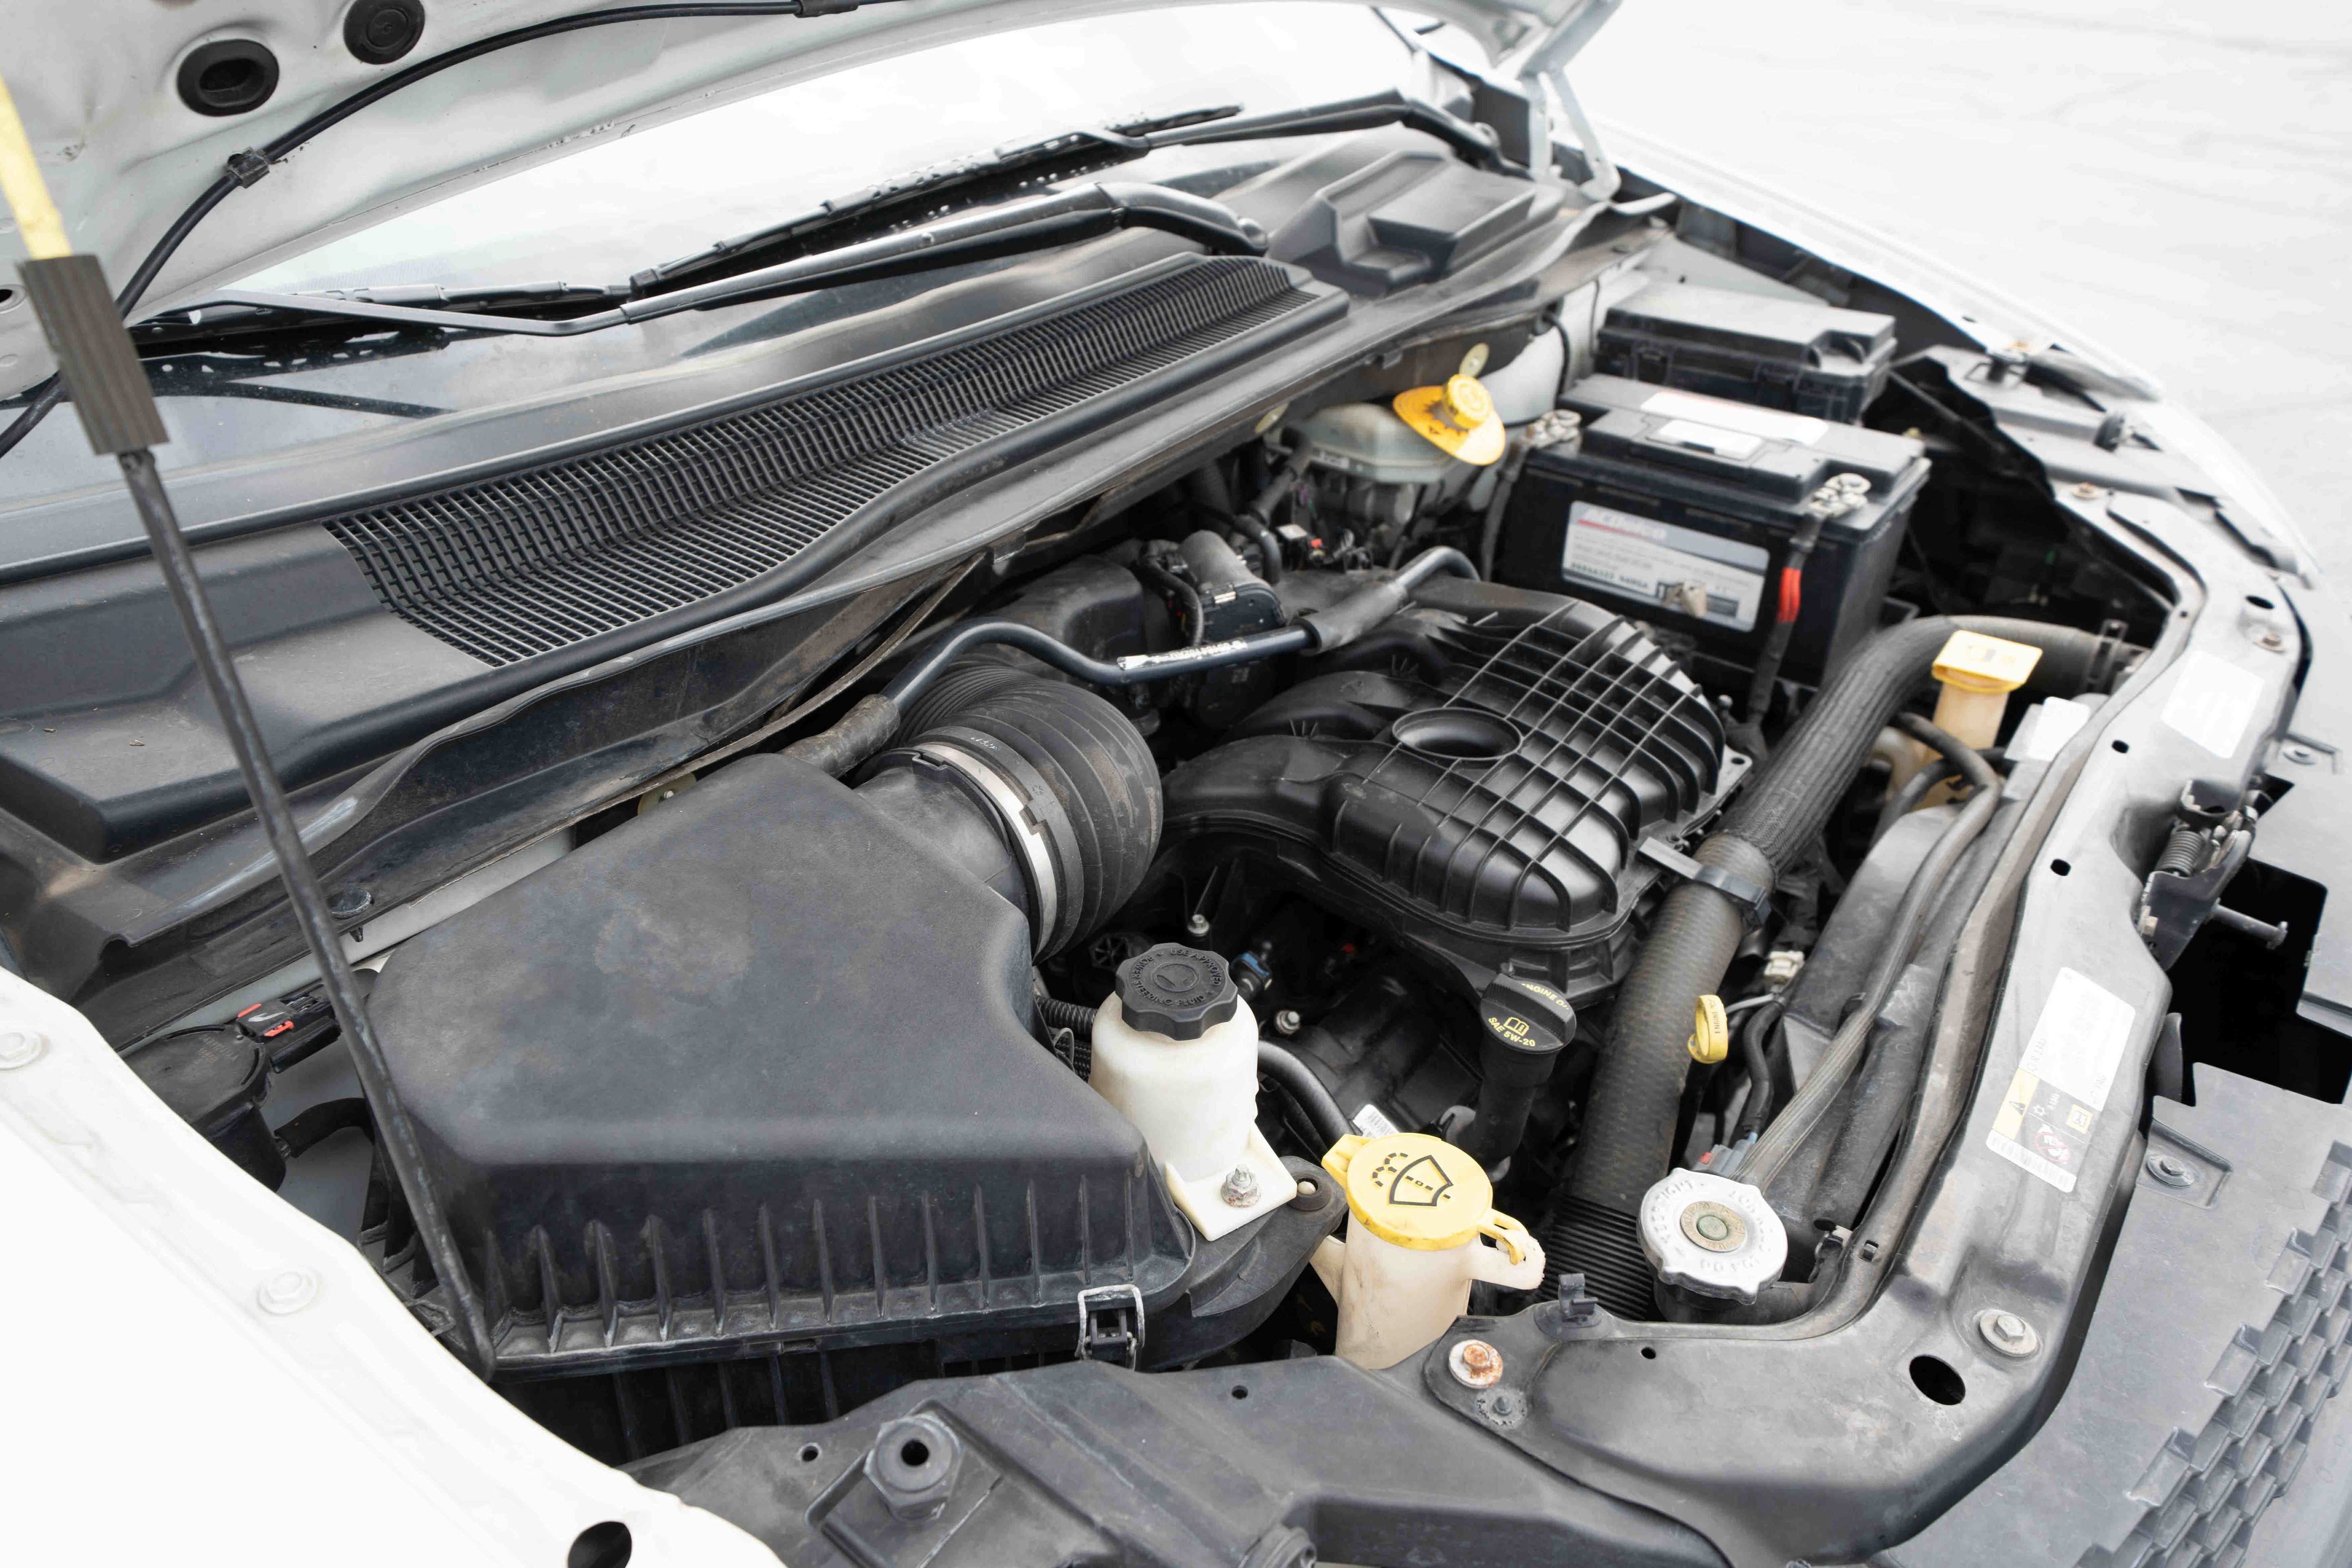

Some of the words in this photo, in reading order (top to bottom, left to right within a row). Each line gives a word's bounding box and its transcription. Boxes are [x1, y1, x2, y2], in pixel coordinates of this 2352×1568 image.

[1132, 955, 1154, 979] POWER
[1170, 948, 1189, 957] USE
[1190, 951, 1222, 987] APPROVED
[1133, 980, 1173, 1006] STEERING
[1176, 995, 1205, 1006] FLUID
[1521, 983, 1557, 1001] NGINE
[1488, 1017, 1505, 1032] SAE
[1503, 1032, 1536, 1047] 5W-20
